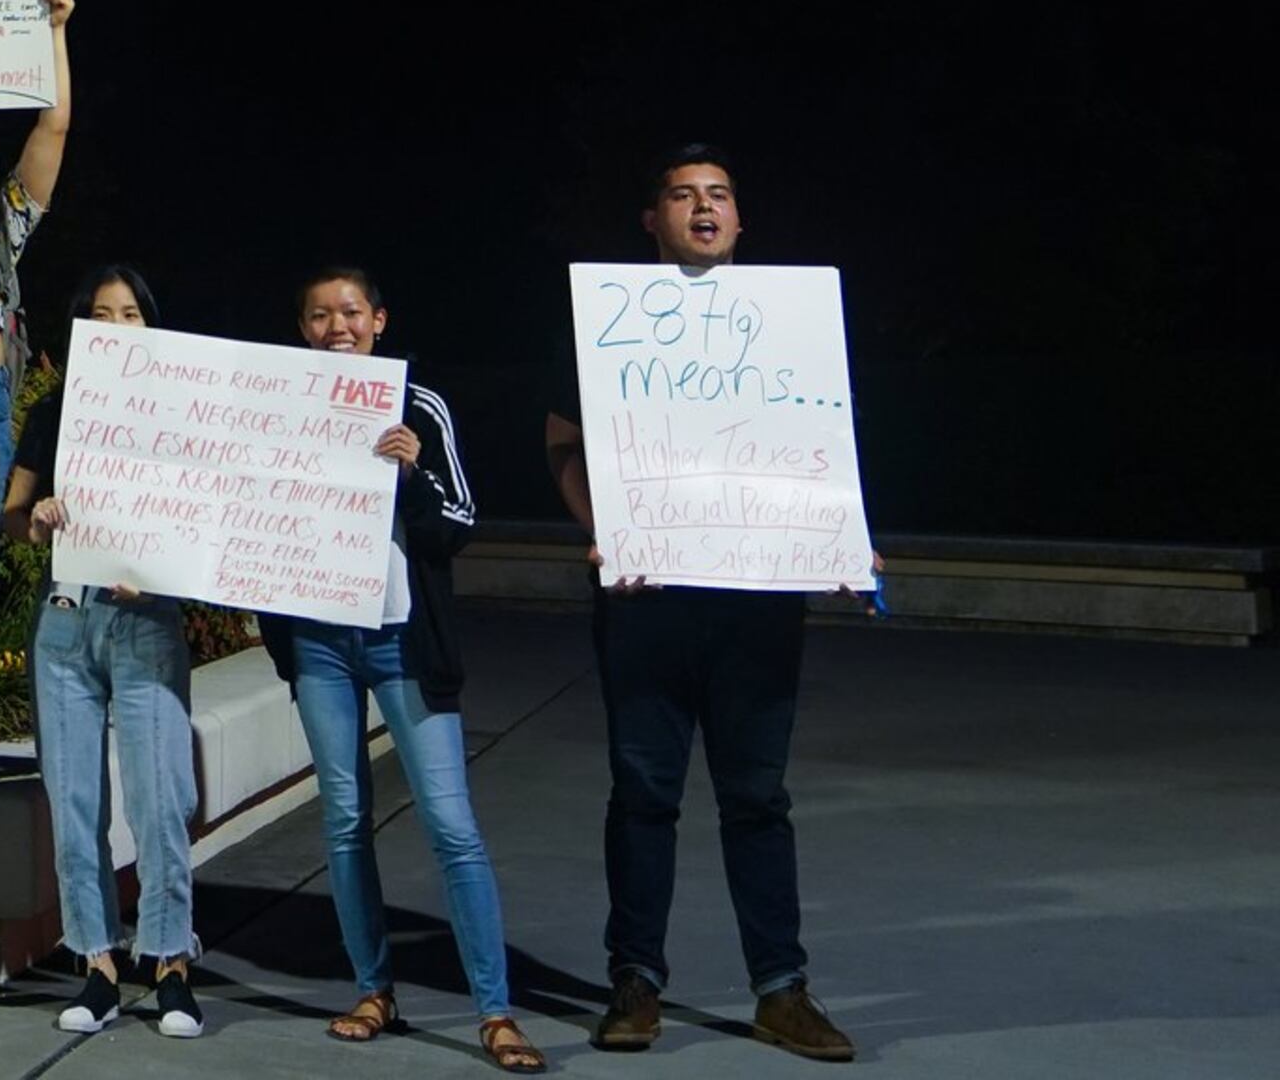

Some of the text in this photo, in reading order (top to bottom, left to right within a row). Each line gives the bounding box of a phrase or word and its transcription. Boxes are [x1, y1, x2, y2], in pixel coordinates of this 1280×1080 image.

[301, 371, 325, 398] I
[329, 373, 397, 410] HATE
[124, 395, 157, 417] ALL
